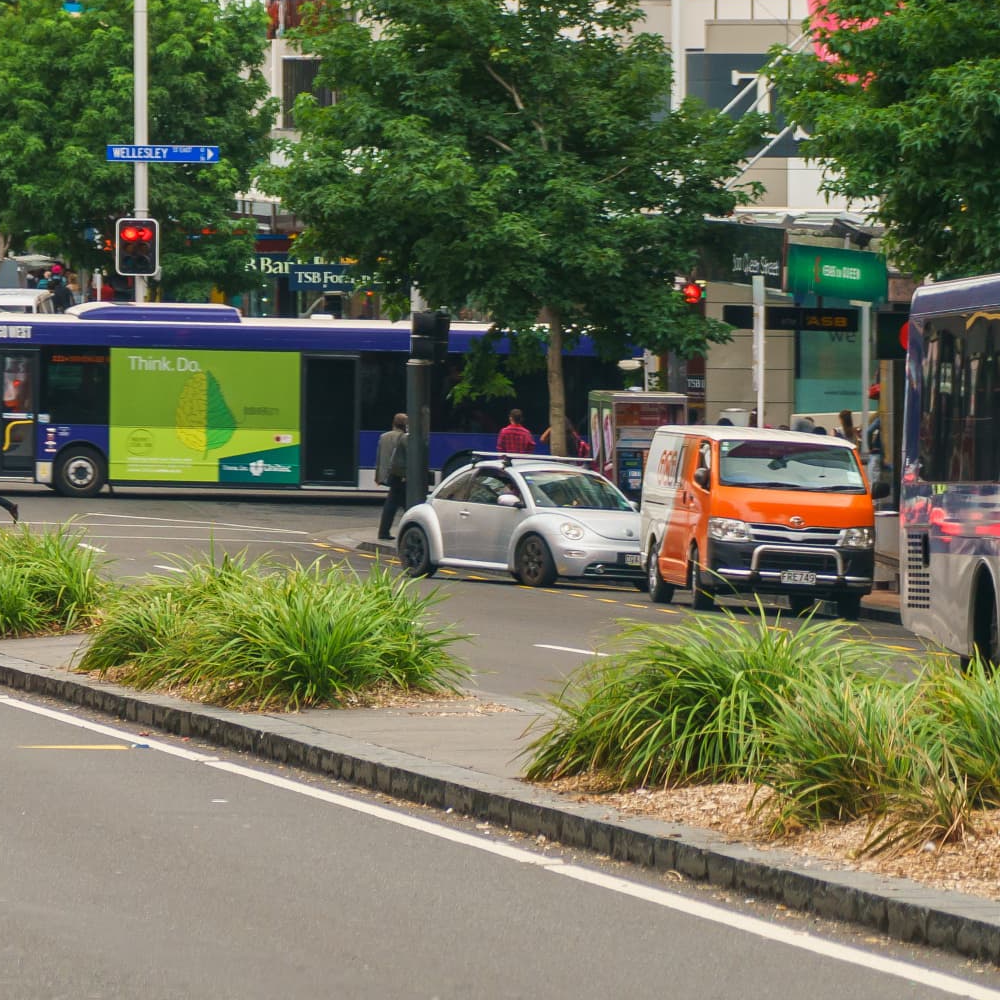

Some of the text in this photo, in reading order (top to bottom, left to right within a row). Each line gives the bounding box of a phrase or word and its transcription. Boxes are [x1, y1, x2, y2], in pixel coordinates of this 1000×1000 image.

[112, 147, 168, 159] WELLESLEY
[295, 271, 321, 284] TSB
[807, 316, 849, 327] ASB
[128, 355, 175, 372] Think.
[176, 357, 202, 372] Do.
